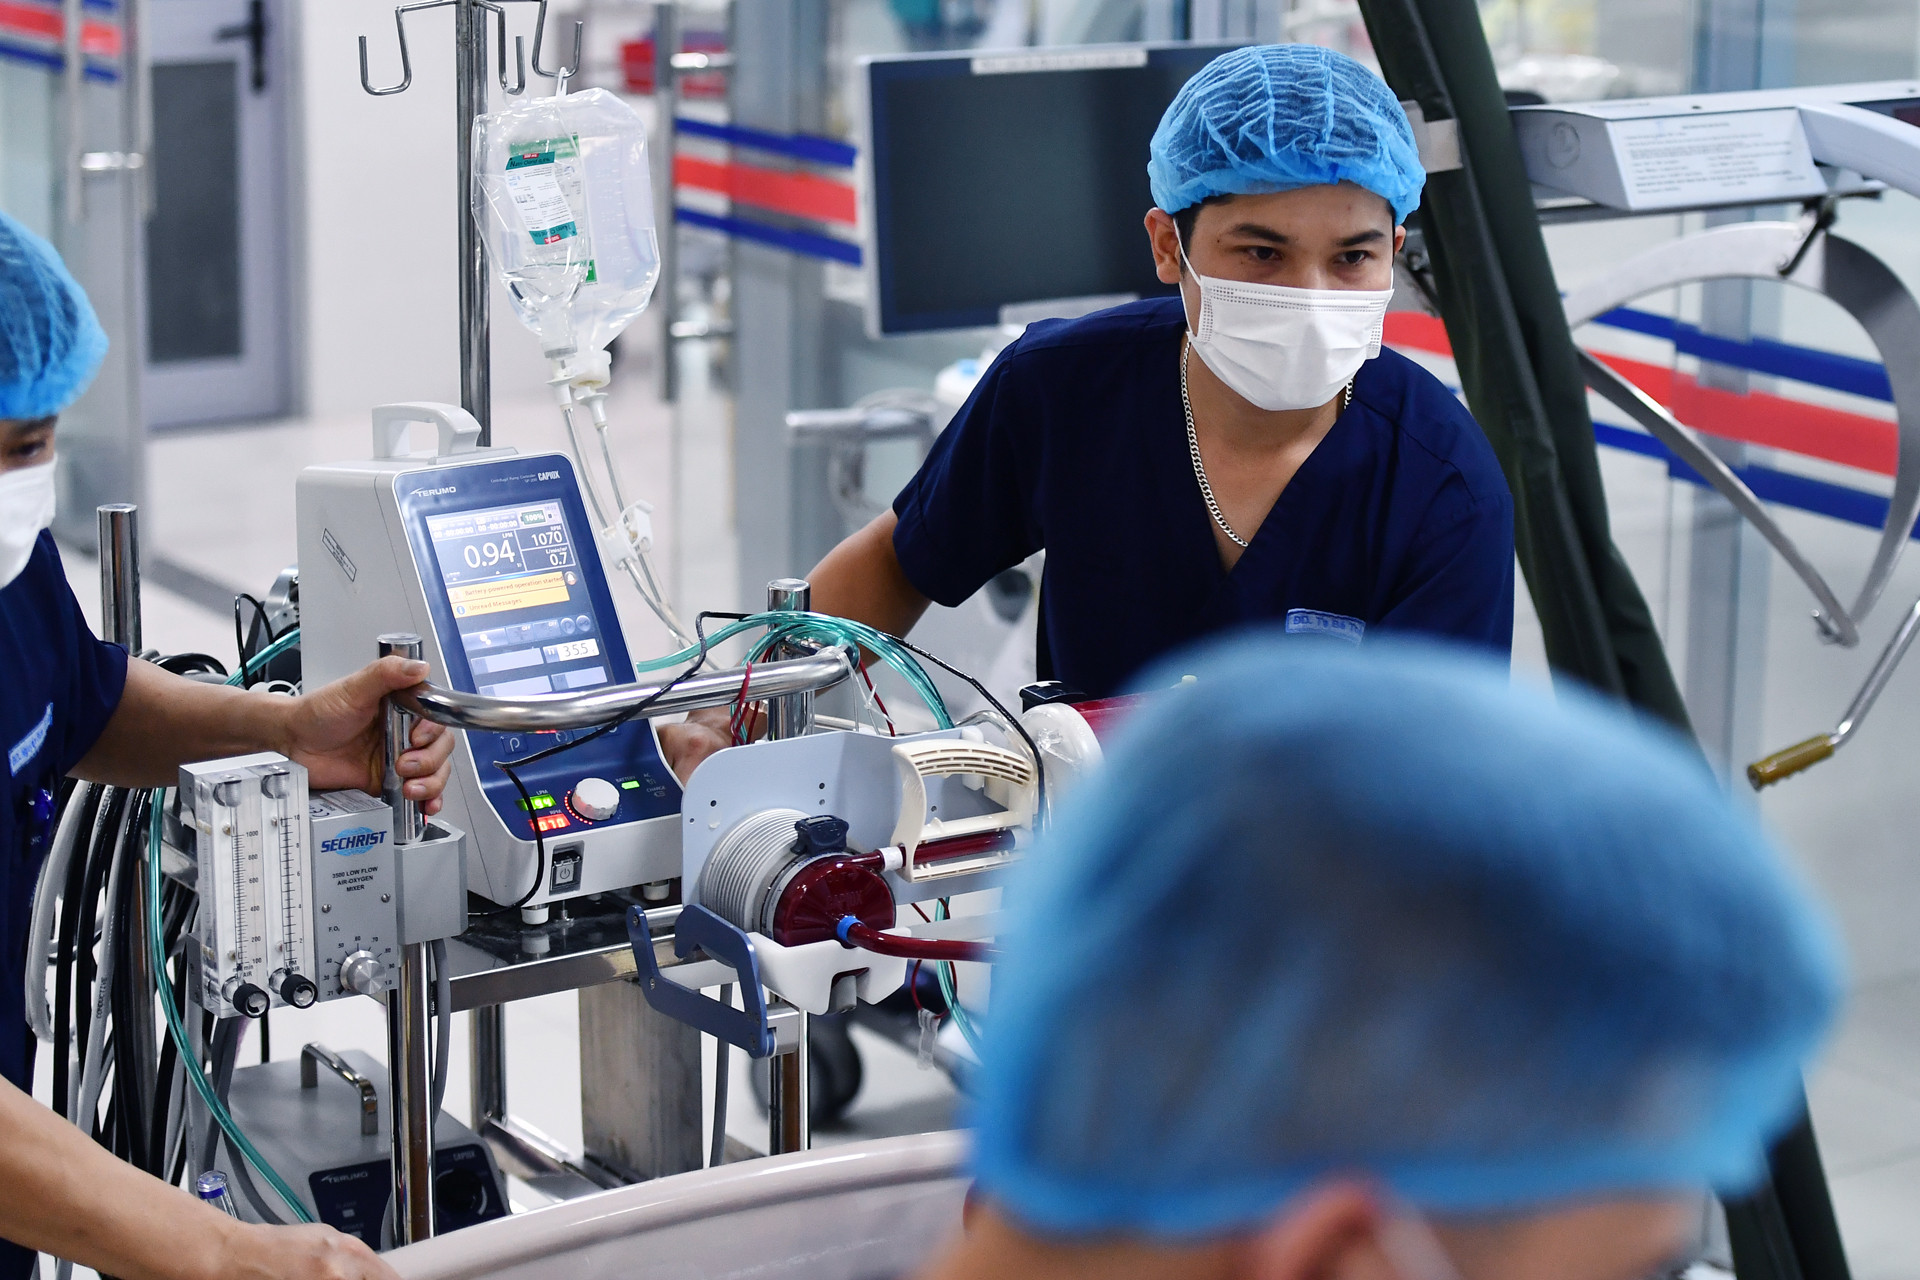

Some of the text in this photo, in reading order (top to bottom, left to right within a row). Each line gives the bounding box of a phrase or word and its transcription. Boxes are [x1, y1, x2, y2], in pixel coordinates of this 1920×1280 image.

[538, 470, 560, 482] CAPIOX
[416, 486, 456, 497] TERUMO
[524, 514, 544, 522] 100%
[532, 530, 562, 546] 1070
[464, 540, 515, 568] 0.94
[550, 552, 567, 566] 0.7
[515, 580, 542, 588] operation
[544, 576, 564, 584] started
[470, 598, 522, 612] Unread Messages
[564, 642, 588, 658] 35.5
[320, 830, 388, 853] SECHRIST
[337, 875, 374, 886] AIR-OXYGEN
[96, 976, 108, 1019] CONDUCTIVE
[328, 1170, 368, 1184] TERUMO
